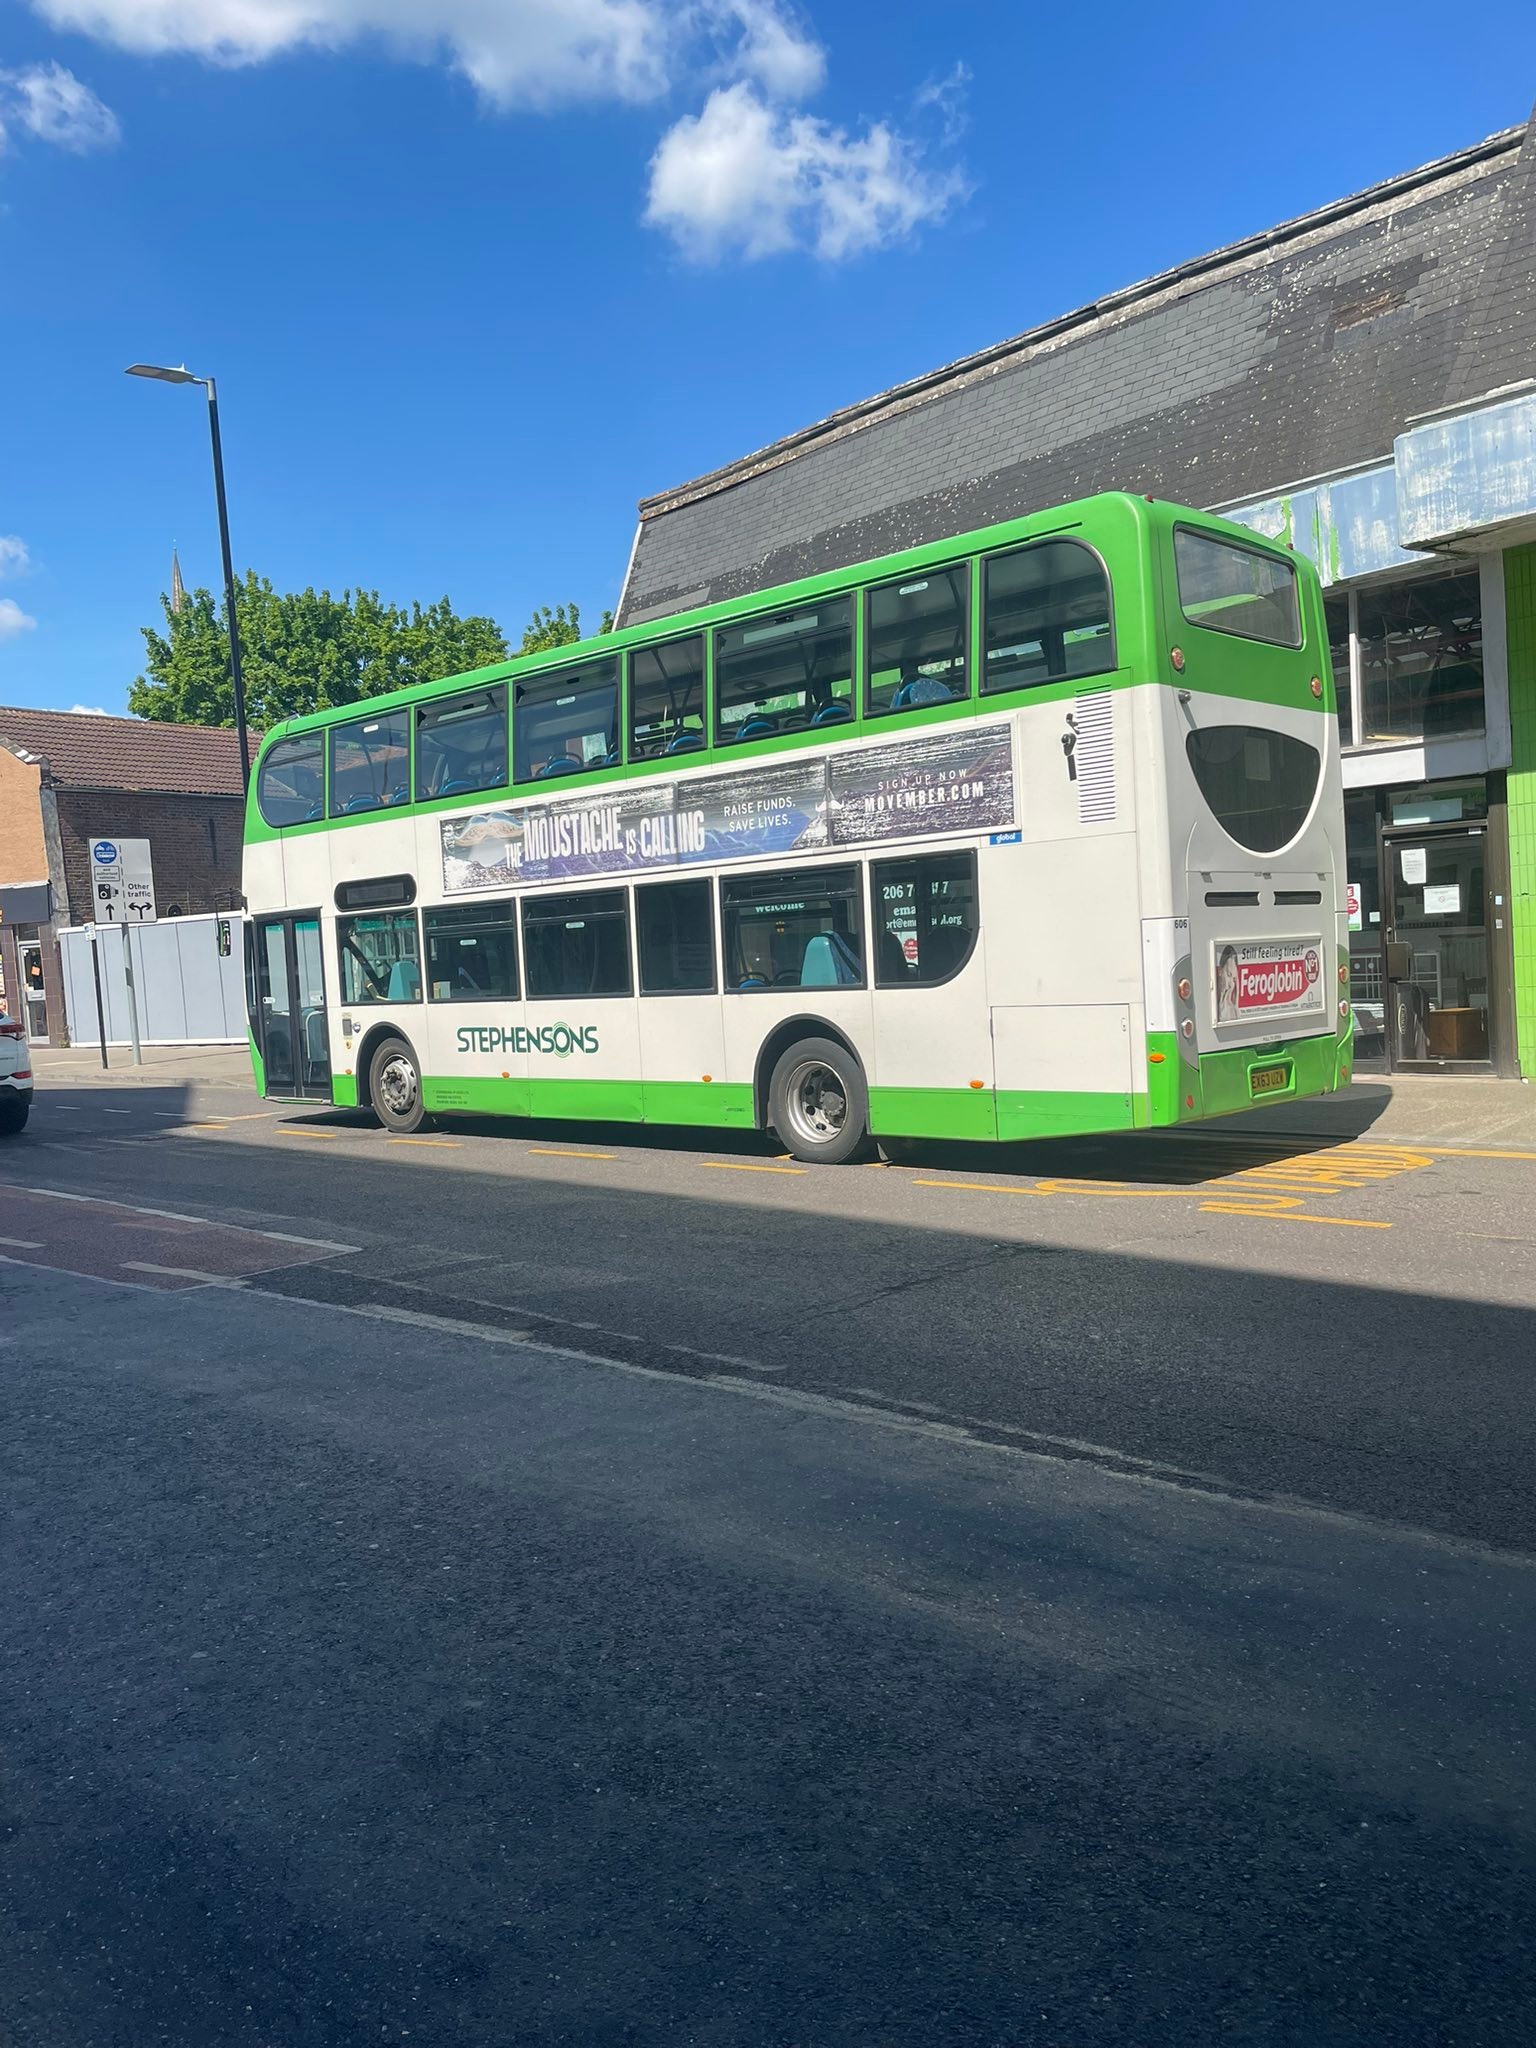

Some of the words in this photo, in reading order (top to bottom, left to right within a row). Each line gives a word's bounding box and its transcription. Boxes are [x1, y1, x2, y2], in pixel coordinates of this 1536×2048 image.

[878, 778, 912, 791] SIGN
[915, 775, 930, 787] UP
[939, 769, 967, 781] NOW
[723, 801, 753, 817] RAISE
[757, 796, 796, 811] FUNDS.
[864, 781, 985, 813] MOVEMBER.COM
[729, 819, 756, 833] SAVE
[758, 815, 792, 830] LIVES.
[505, 842, 523, 868] THE
[523, 807, 623, 862] MOUSTACHE
[626, 829, 636, 855] IS
[640, 810, 705, 858] CALLING
[996, 832, 1015, 843] global
[128, 890, 152, 898] traffic
[1174, 919, 1188, 928] 606
[1241, 947, 1257, 960] Still
[1258, 946, 1282, 960] feeling
[1284, 945, 1304, 957] tired?
[1240, 963, 1302, 1001] Feroglobin
[457, 1026, 599, 1054] STEPHENSONS
